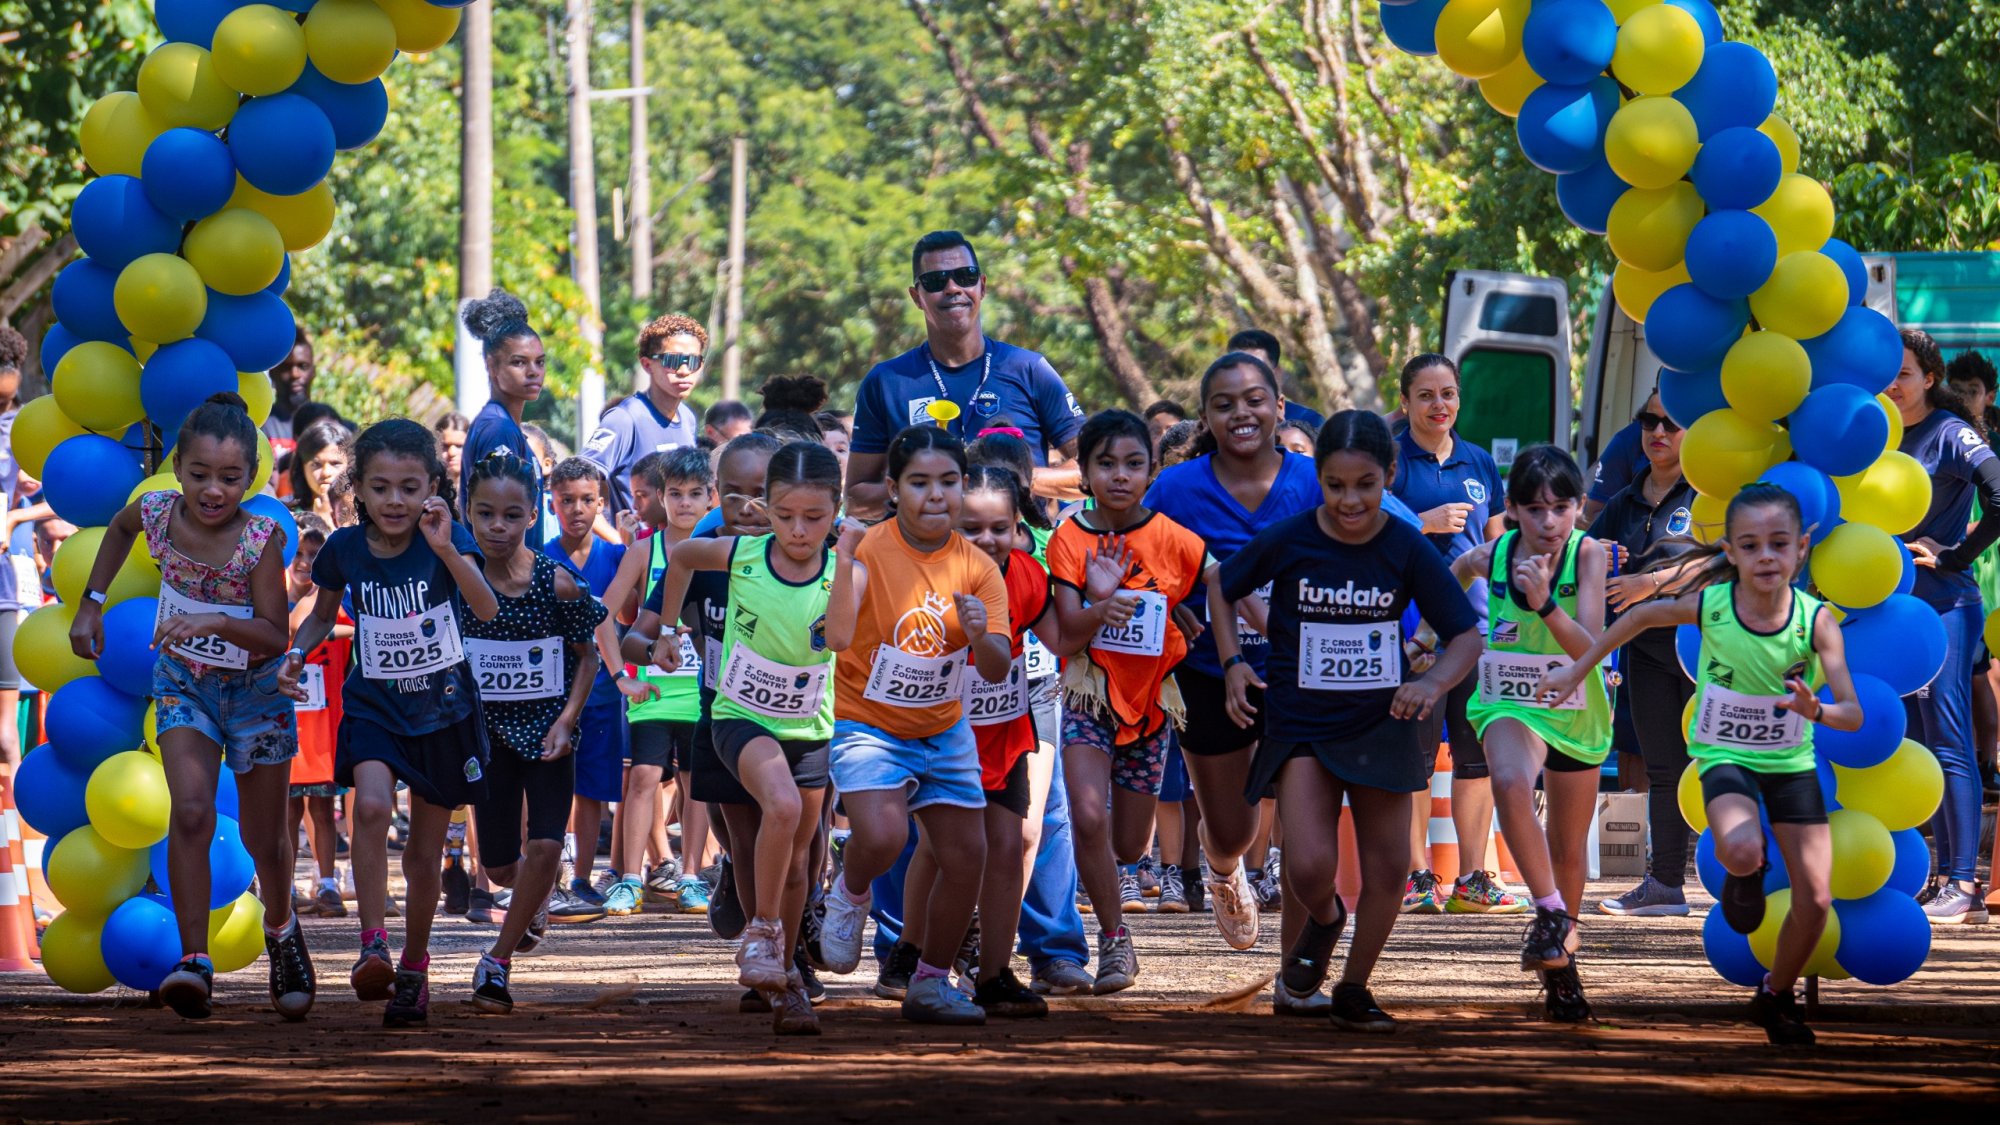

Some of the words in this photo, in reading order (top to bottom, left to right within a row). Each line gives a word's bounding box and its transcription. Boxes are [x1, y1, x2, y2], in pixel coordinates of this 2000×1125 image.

[1299, 578, 1394, 608] fundato
[384, 631, 415, 640] CROSS
[375, 638, 418, 647] COUNTRY
[1332, 640, 1363, 648] CROSS
[377, 641, 443, 668] 2025
[1320, 646, 1365, 655] COUNTRY
[480, 661, 524, 669] COUNTRY
[905, 666, 936, 676] CROSS
[1320, 657, 1383, 678] 2025
[1508, 665, 1540, 673] CROSS
[480, 670, 544, 690] 2025
[744, 669, 788, 690] COUNTRY
[756, 669, 788, 683] CROSS
[892, 670, 936, 682] COUNTRY
[738, 680, 804, 710] 2025
[886, 679, 948, 699] 2025
[971, 684, 1008, 694] COUNTRY
[968, 690, 1018, 715] 2025
[1720, 710, 1767, 721] COUNTRY
[1733, 706, 1766, 715] CROSS
[1717, 720, 1785, 741] 2025
